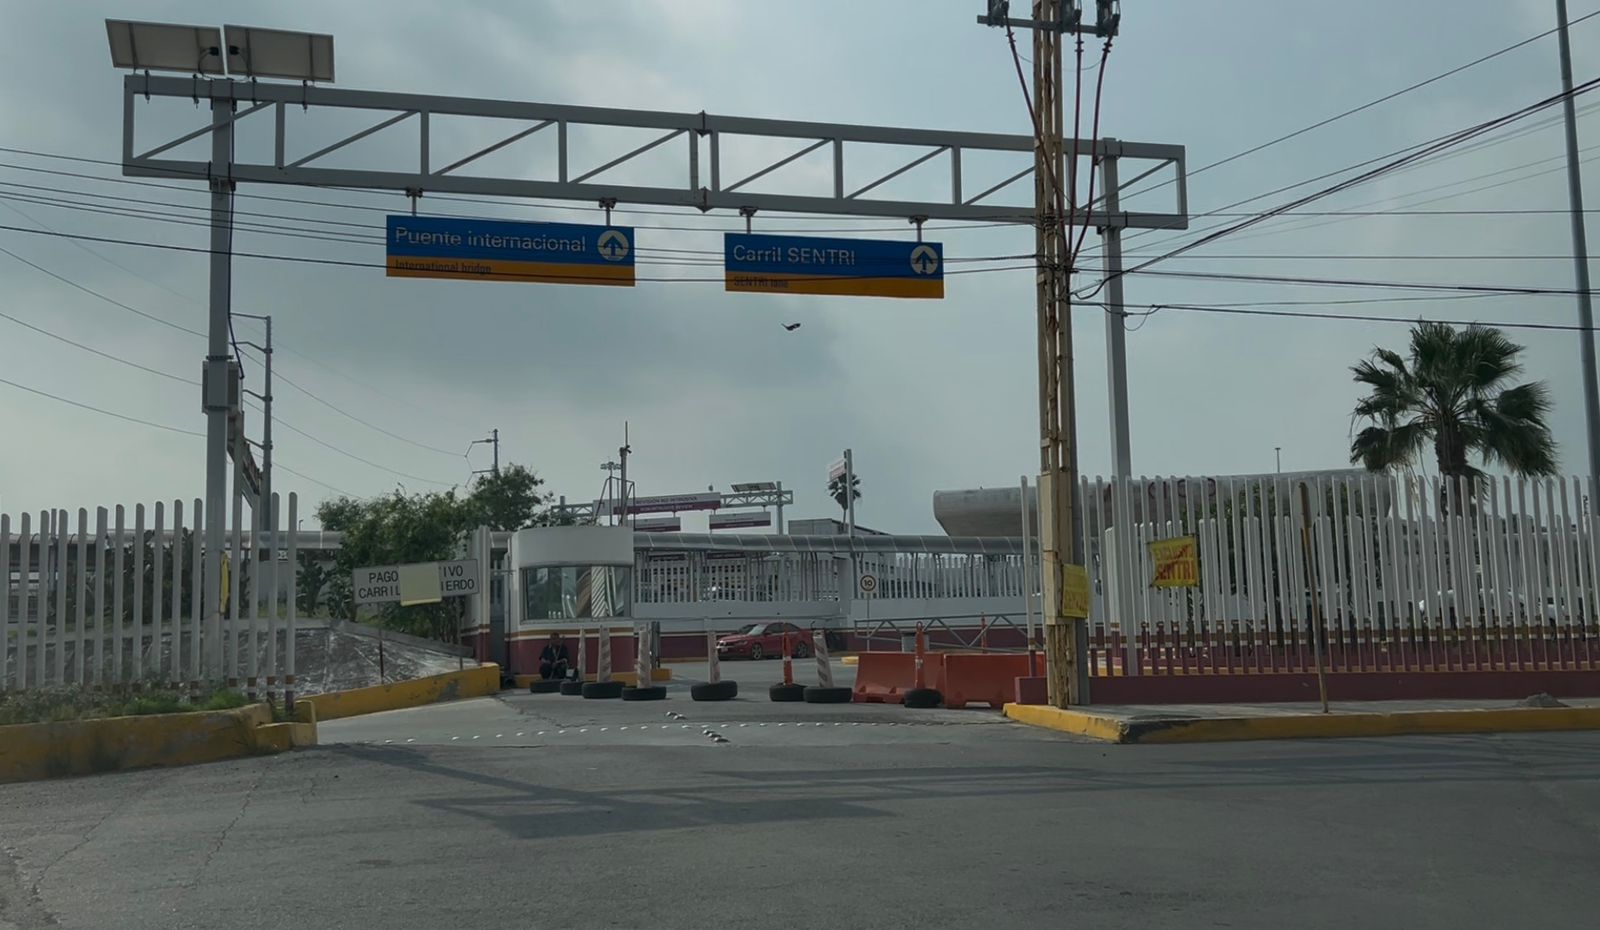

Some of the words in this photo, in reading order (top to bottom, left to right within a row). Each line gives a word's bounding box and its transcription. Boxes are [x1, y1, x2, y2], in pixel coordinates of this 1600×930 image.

[395, 226, 462, 246] Puente
[468, 230, 586, 252] internacional
[733, 244, 781, 262] Carril
[787, 247, 855, 266] SENTRI
[395, 259, 459, 273] International
[462, 262, 492, 275] bridge
[734, 276, 768, 287] SENTRI
[368, 570, 399, 583] PAGO
[863, 579, 873, 587] 10
[358, 586, 400, 599] CARRIL
[441, 579, 475, 591] IERDO
